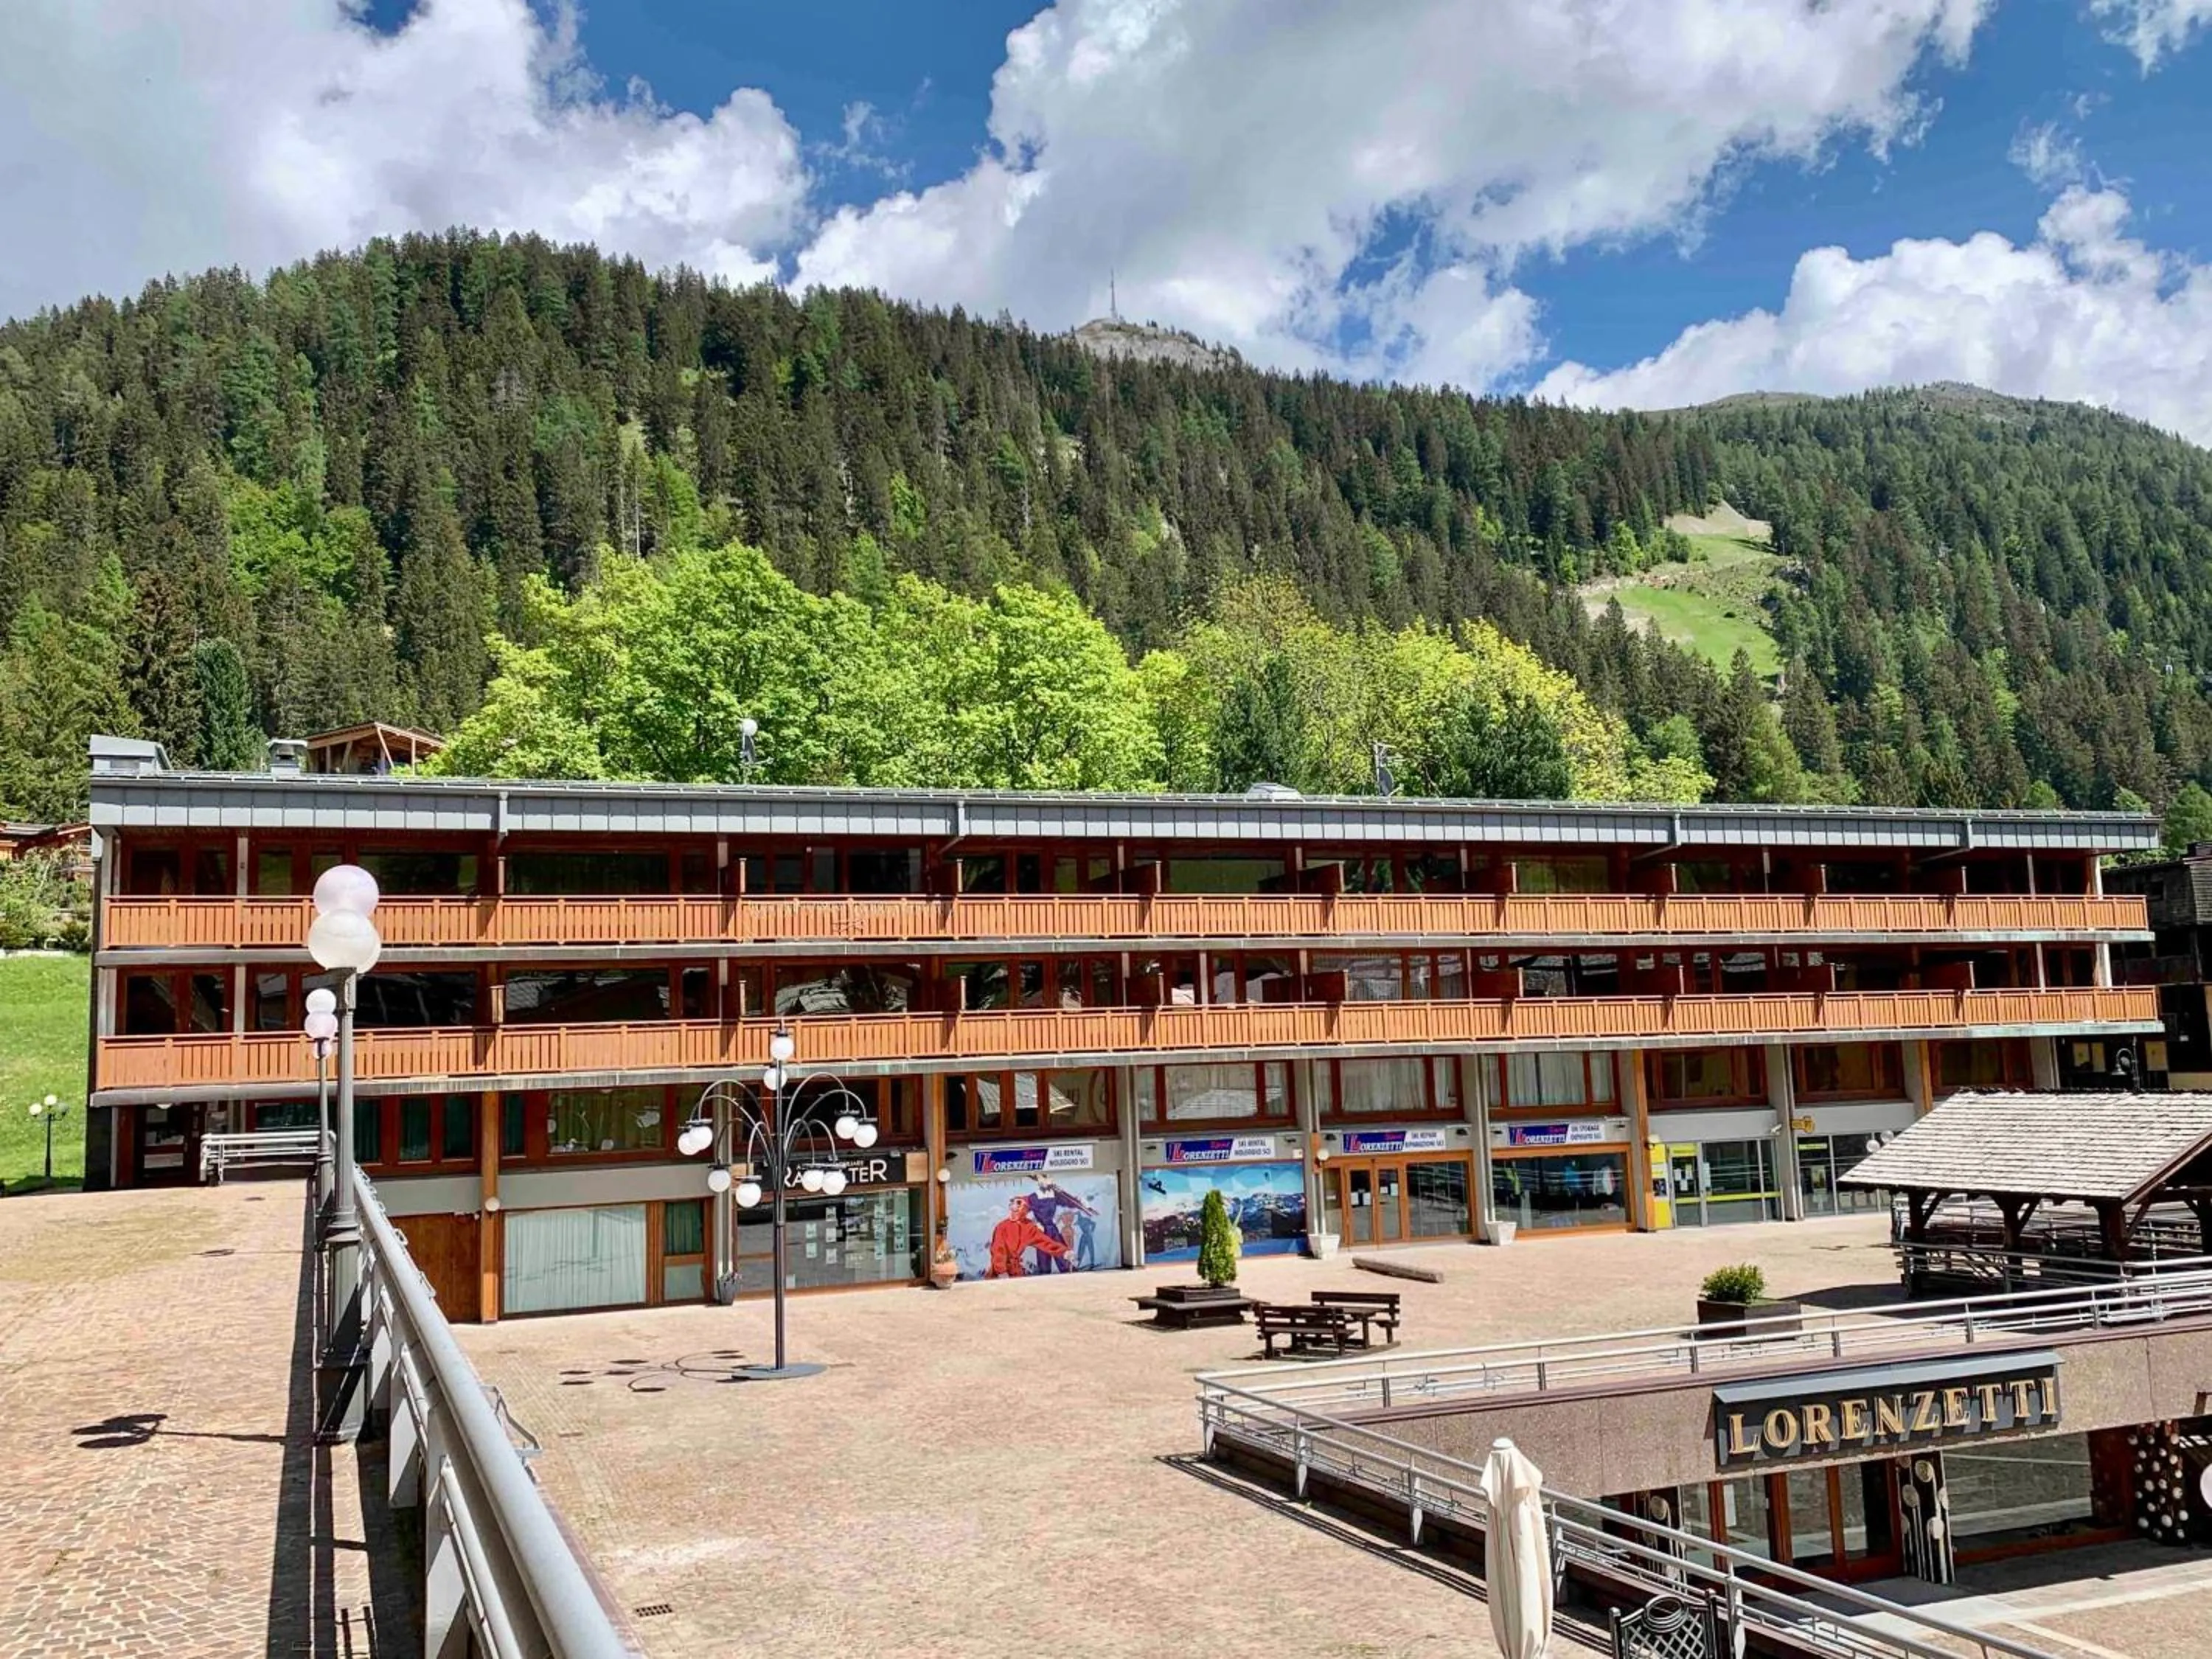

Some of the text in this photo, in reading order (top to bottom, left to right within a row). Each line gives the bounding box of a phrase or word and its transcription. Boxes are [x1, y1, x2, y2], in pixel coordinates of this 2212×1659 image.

[1170, 1142, 1230, 1161] LORENZETTI
[979, 1152, 1044, 1174] LORENZETTI
[1728, 1377, 2059, 1455] LORENZETTI
